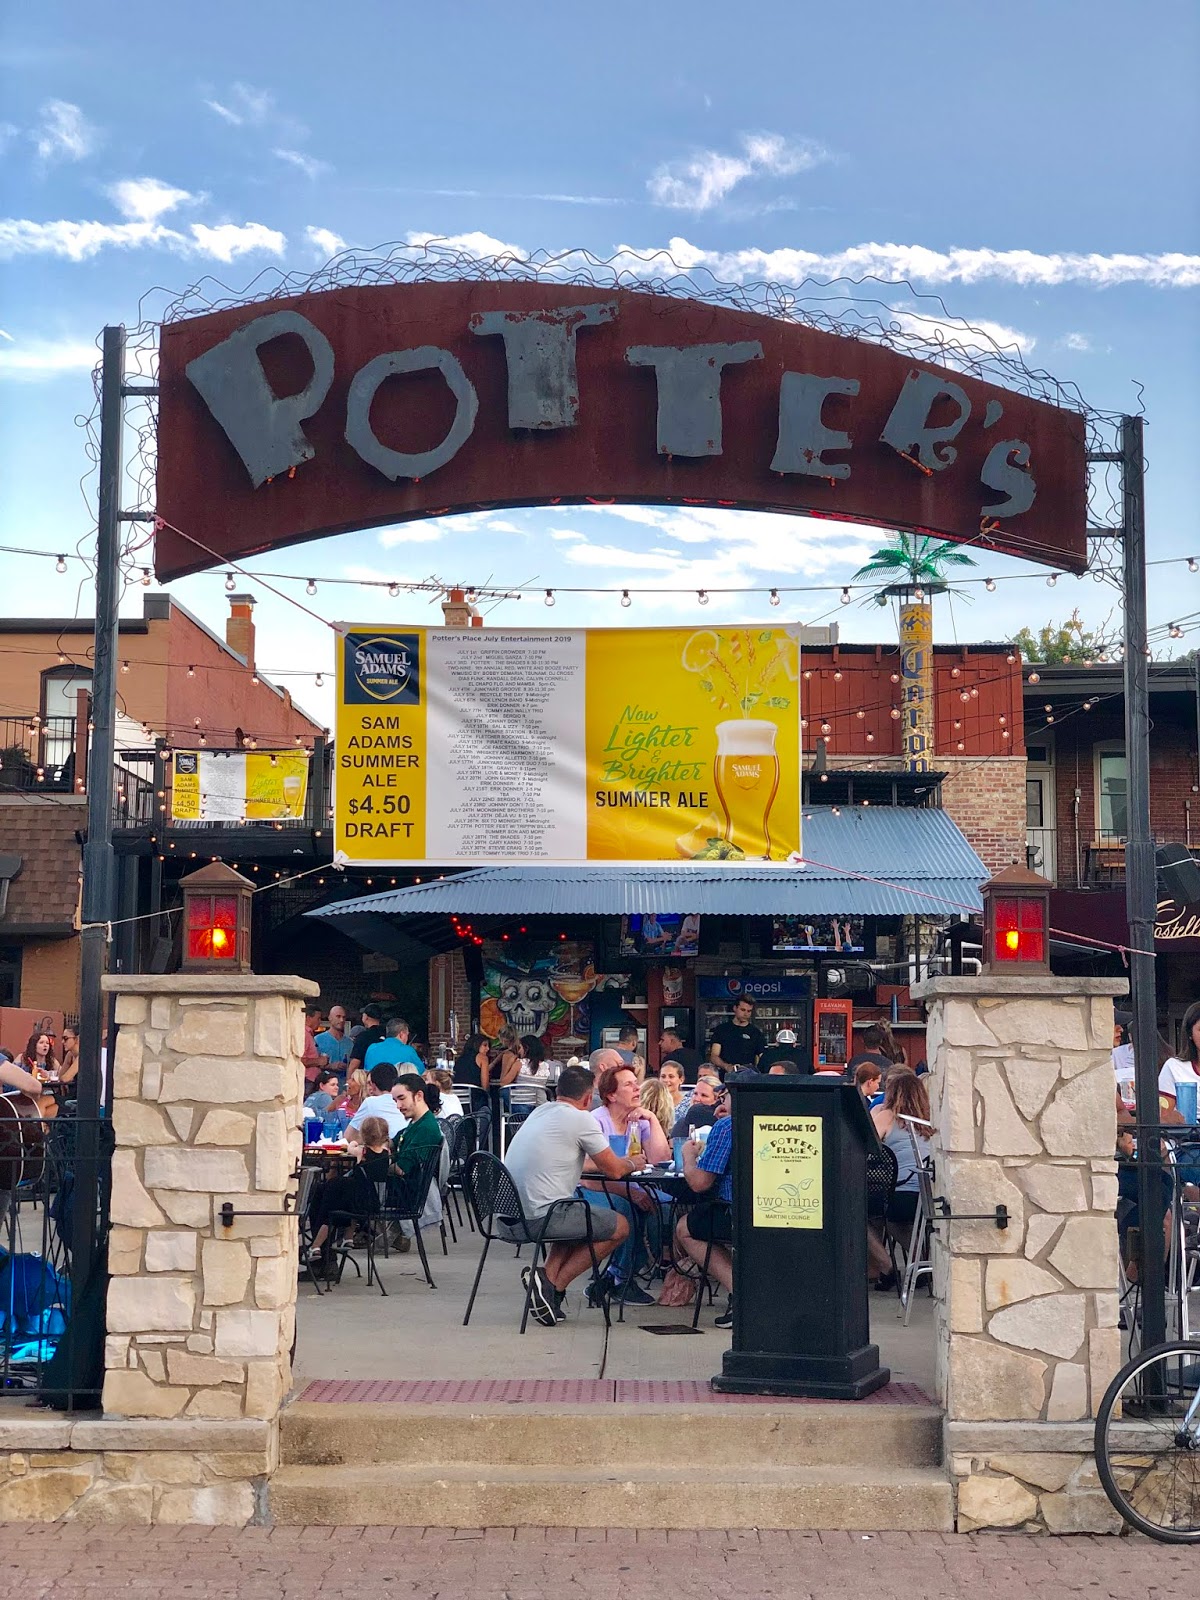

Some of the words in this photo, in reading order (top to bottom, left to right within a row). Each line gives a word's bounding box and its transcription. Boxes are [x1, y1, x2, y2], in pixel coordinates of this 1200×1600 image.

[185, 301, 1038, 519] POTTER'S
[355, 651, 411, 665] SAMUEL
[359, 664, 407, 677] ADAMS
[620, 705, 658, 724] Now
[361, 716, 400, 730] SAM
[348, 736, 412, 748] ADAMS
[603, 725, 698, 762] Lighter
[341, 755, 420, 768] SUMMER
[651, 750, 661, 762] &
[600, 760, 706, 790] Brighter
[731, 764, 762, 772] SAMUEL
[734, 770, 760, 778] ADAMS
[362, 774, 398, 787] ALE
[349, 795, 410, 815] $4.50
[596, 791, 670, 808] SUMMER
[678, 791, 708, 808] ALE
[345, 823, 414, 838] DRAFT
[744, 982, 781, 994] pepsi
[759, 1124, 802, 1132] WELCOME
[805, 1124, 817, 1133] TO
[770, 1138, 820, 1156] POTTER'S
[757, 1194, 820, 1208] two-nine
